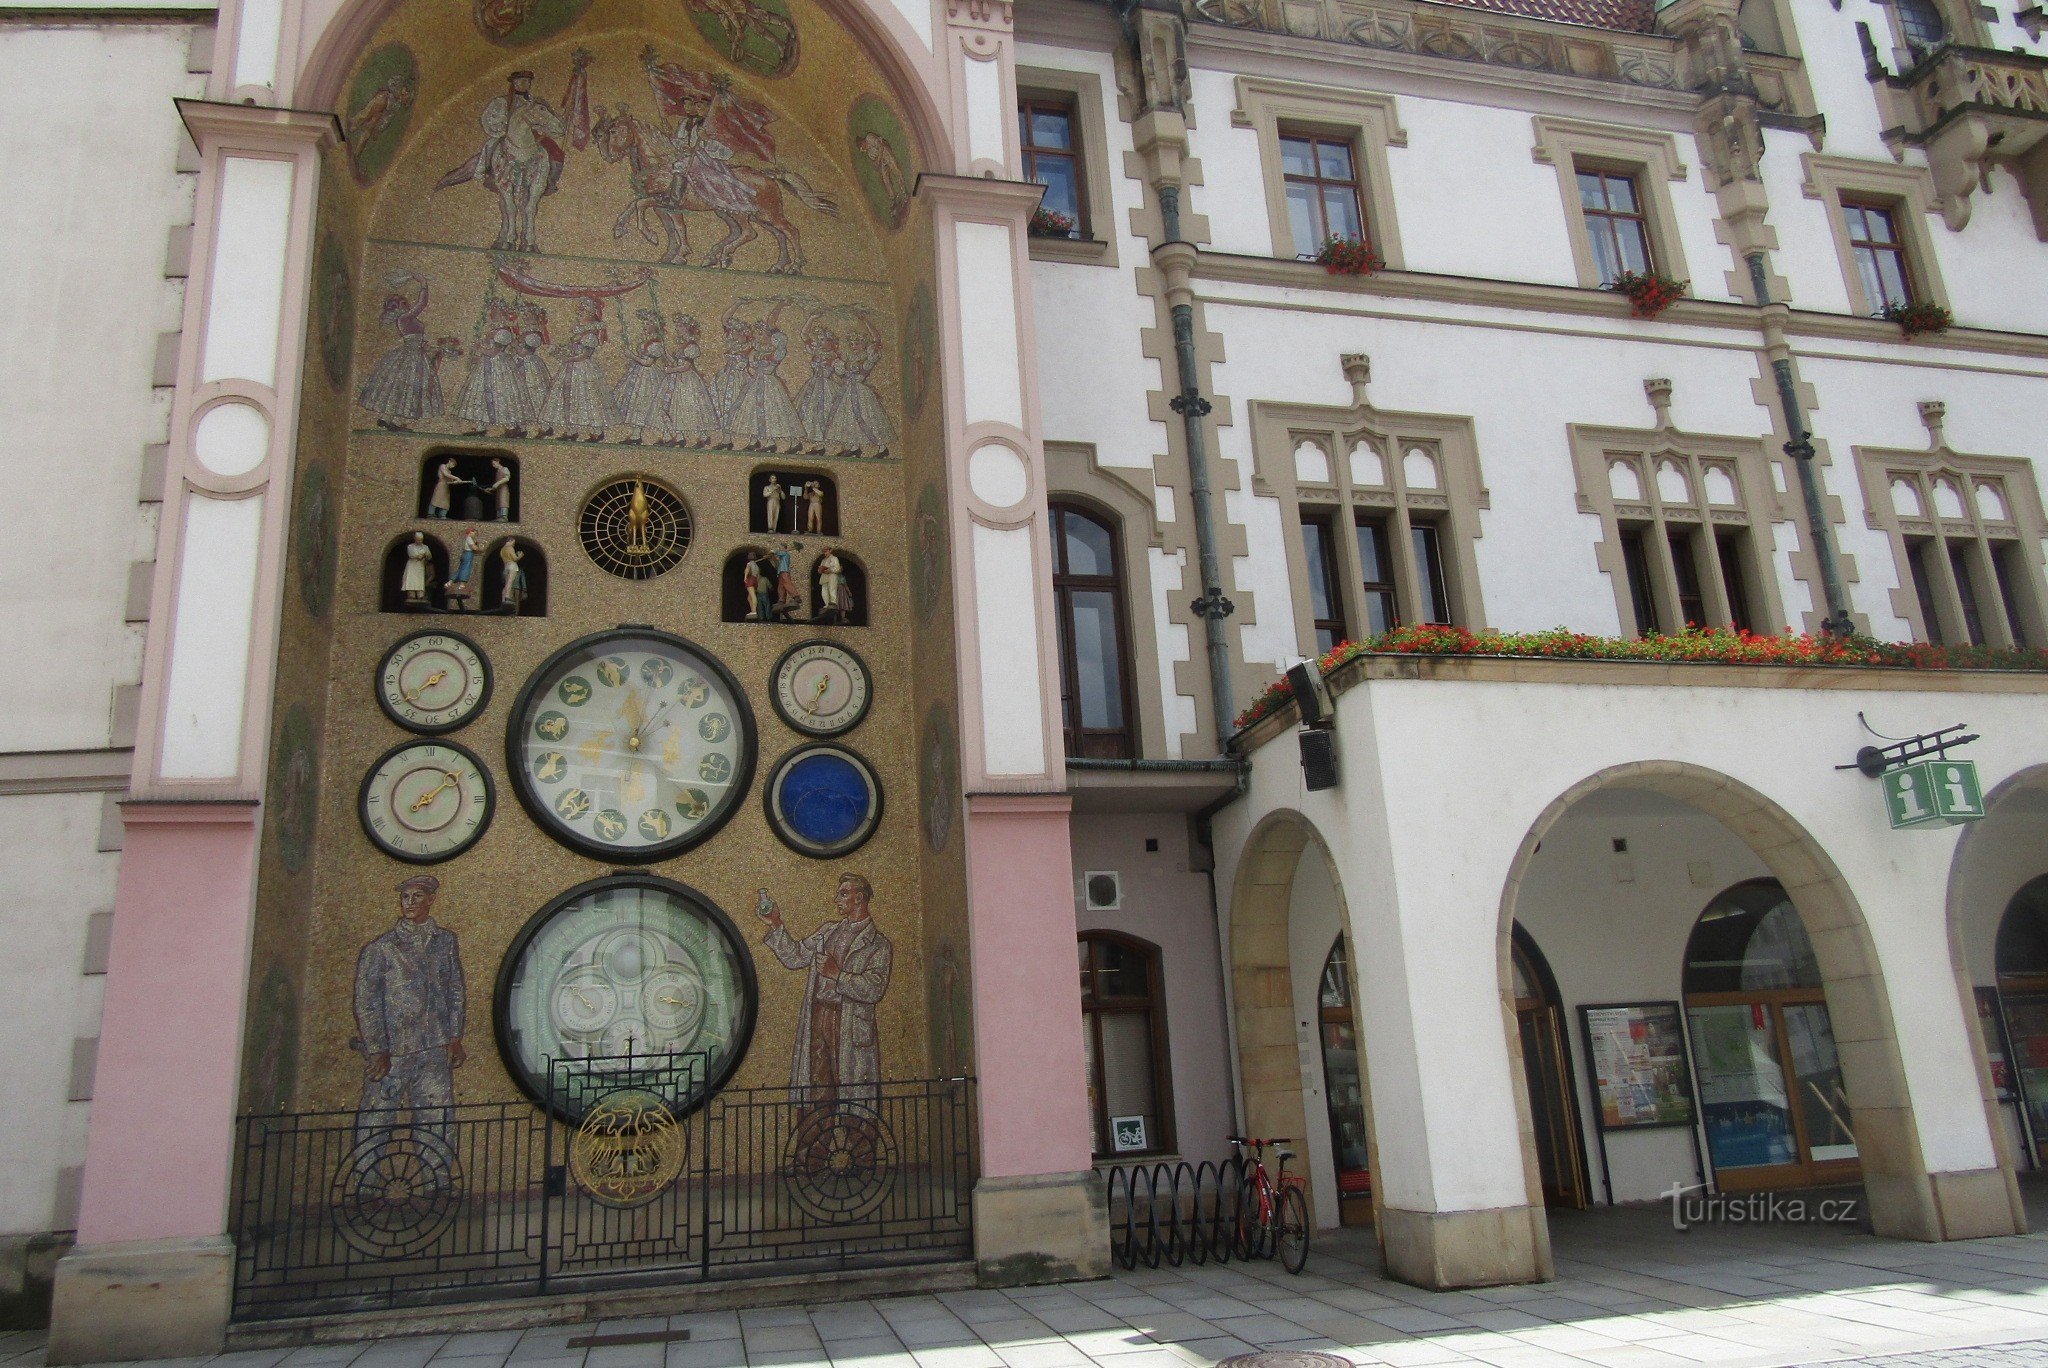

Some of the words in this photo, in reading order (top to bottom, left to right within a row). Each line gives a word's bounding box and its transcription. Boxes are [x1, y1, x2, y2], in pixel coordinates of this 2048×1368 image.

[429, 637, 442, 646] 60
[408, 642, 420, 652] 55
[392, 654, 403, 667] 50
[467, 656, 478, 666] 10
[386, 674, 395, 685] 45
[473, 676, 482, 685] 15
[389, 693, 401, 705] 40
[464, 694, 477, 705] 20
[404, 708, 418, 719] 35
[448, 708, 461, 719] 25
[426, 715, 440, 724] 30
[425, 747, 435, 756] XII
